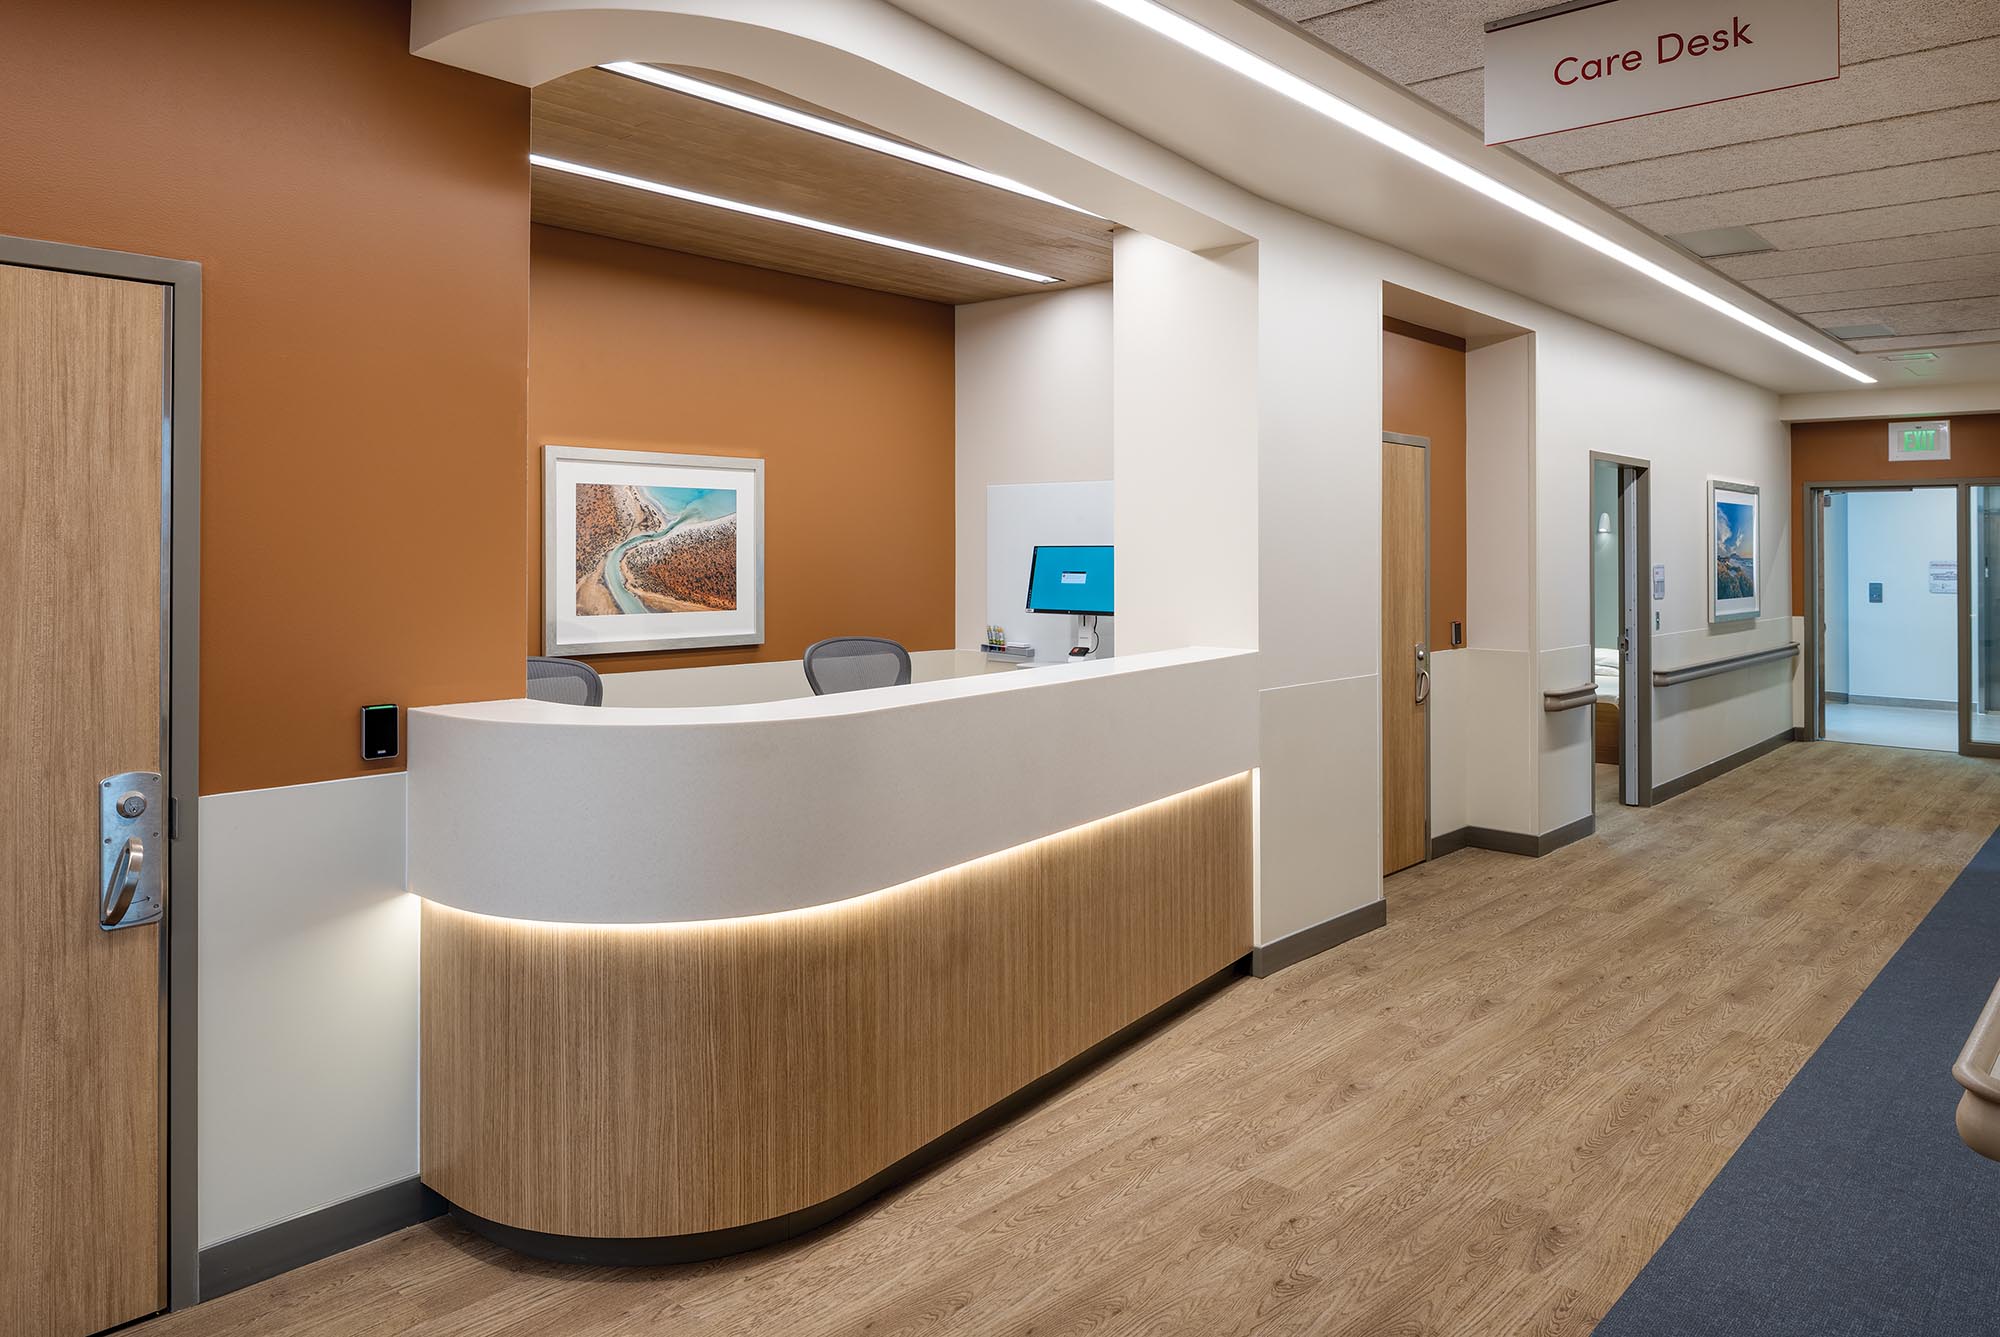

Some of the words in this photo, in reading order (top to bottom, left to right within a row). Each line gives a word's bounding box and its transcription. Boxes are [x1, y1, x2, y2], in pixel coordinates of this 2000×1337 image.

[1554, 50, 1642, 86] Care
[1657, 16, 1754, 64] Desk
[1904, 430, 1936, 452] EXIT
